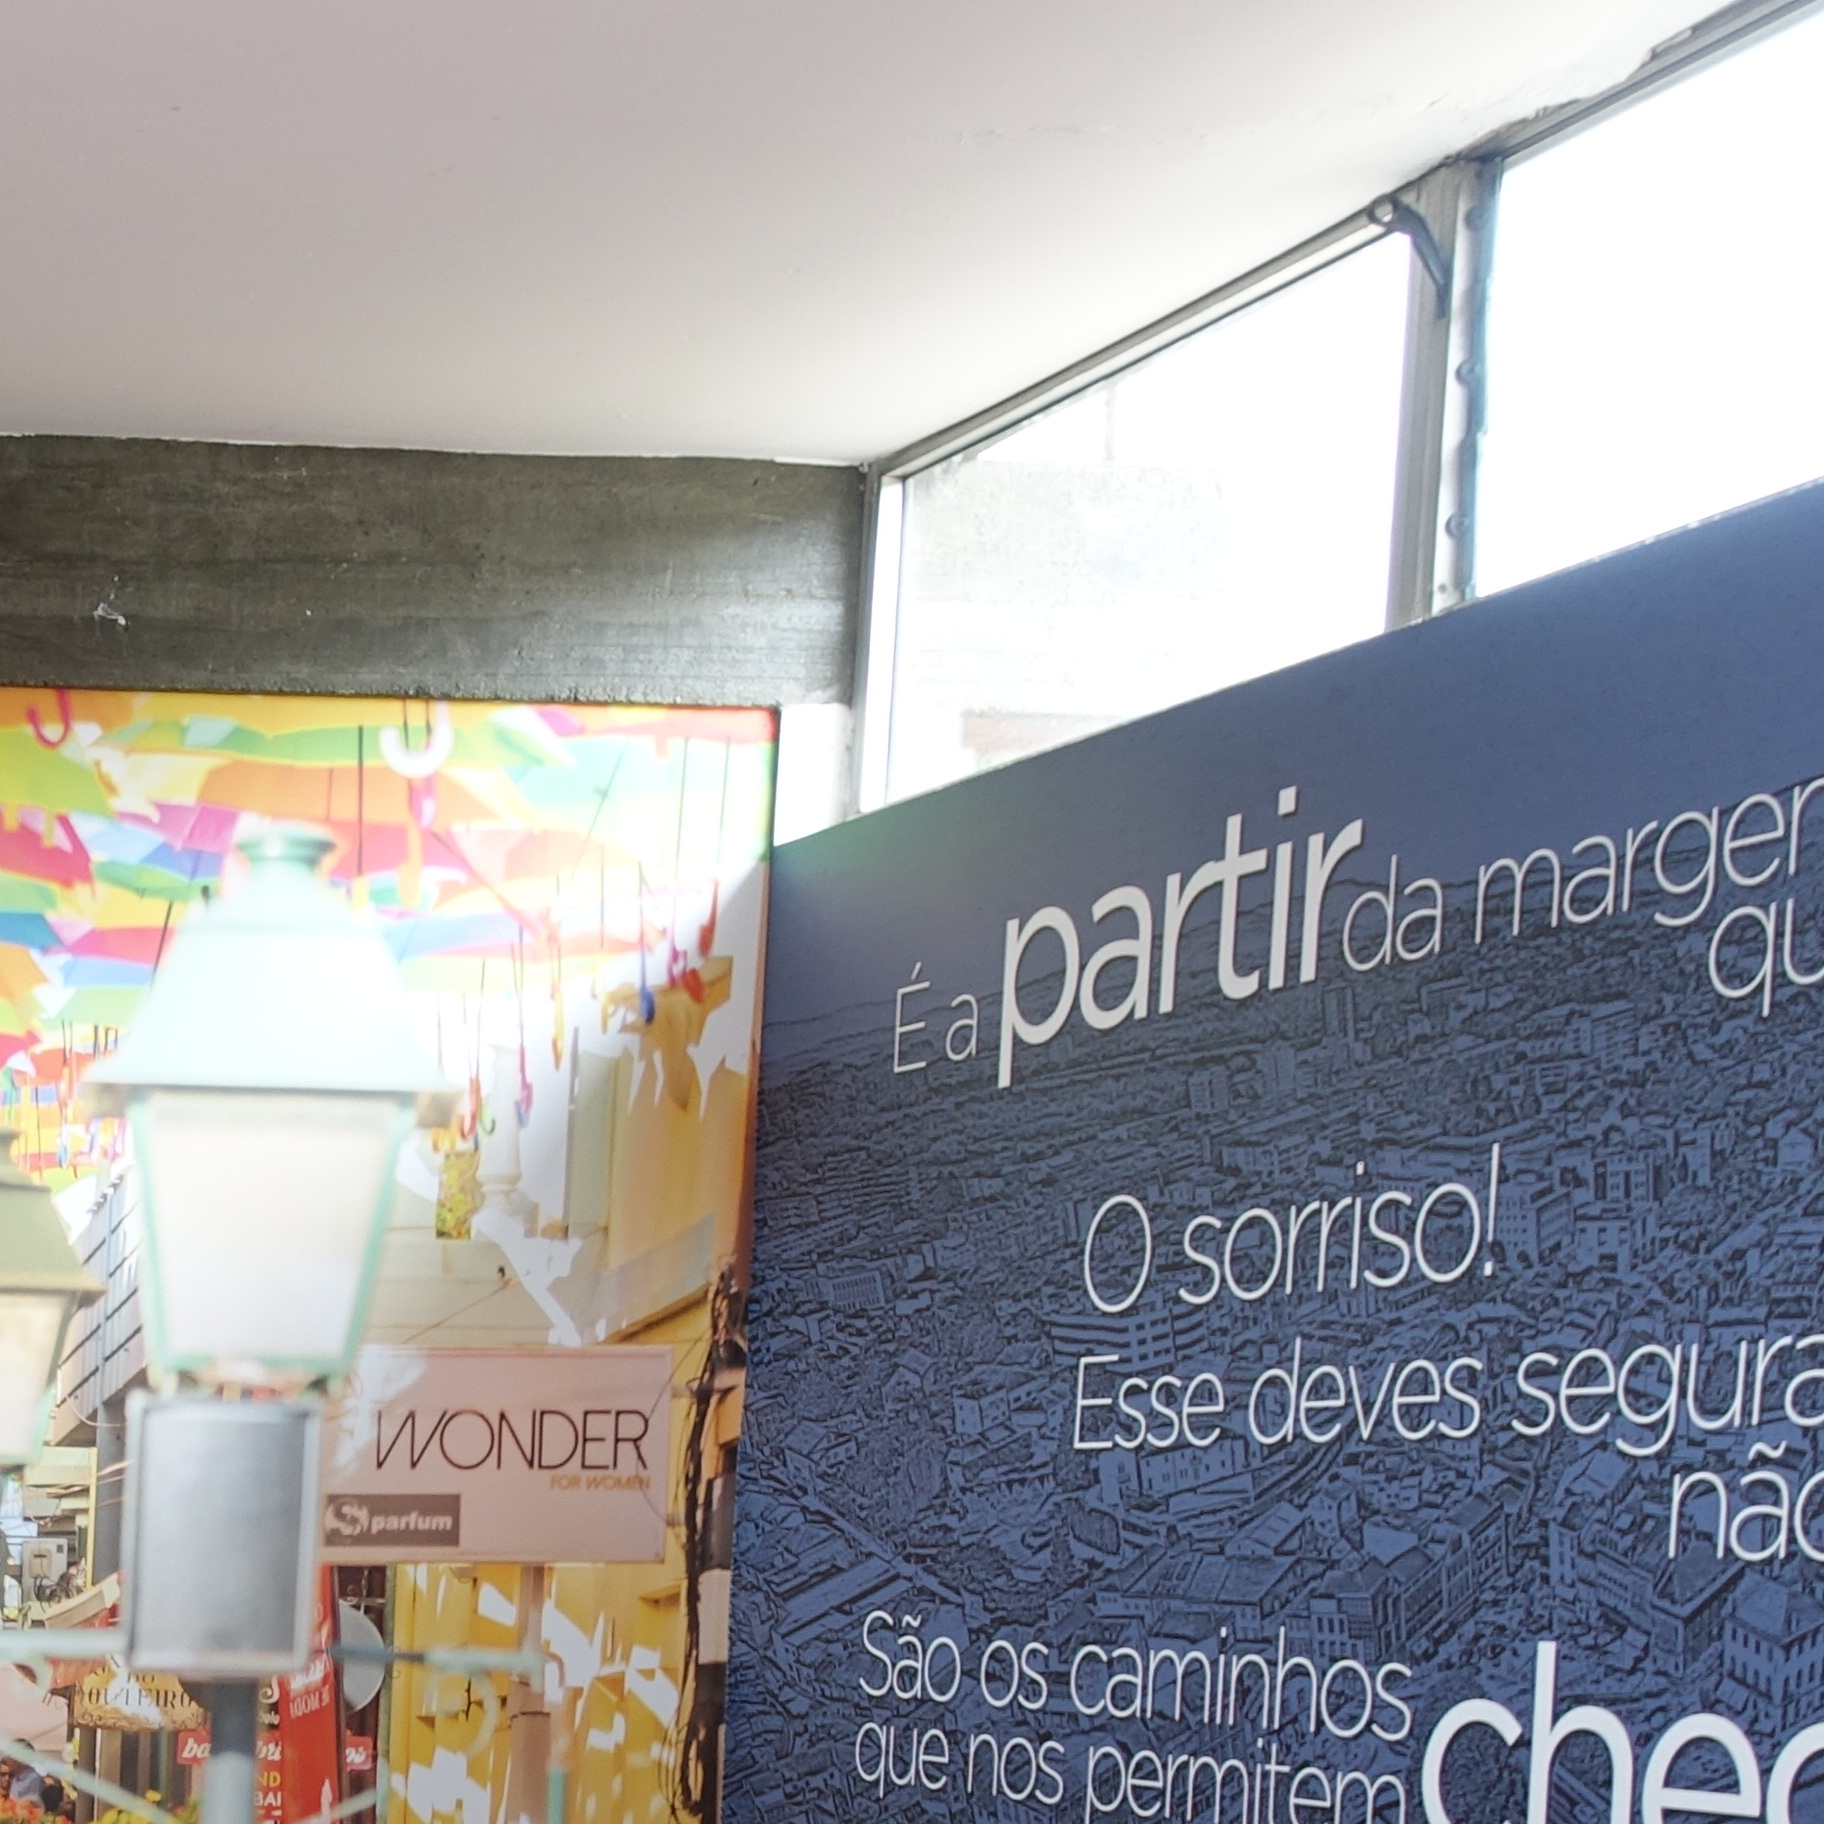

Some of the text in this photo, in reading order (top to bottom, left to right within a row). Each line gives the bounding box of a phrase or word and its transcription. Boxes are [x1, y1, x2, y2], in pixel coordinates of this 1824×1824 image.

[893, 961, 931, 1075] É
[945, 993, 979, 1063] a
[997, 785, 1364, 1089] partir
[1342, 855, 1444, 974] da
[1083, 1142, 1501, 1315] O sorriso!
[375, 1408, 649, 1471] WONDER
[1073, 1354, 1226, 1452] Esse
[1247, 1336, 1483, 1446] deves
[549, 1474, 651, 1491] FOR WOMEN
[858, 1608, 1414, 1743] São os caminhos
[854, 1718, 949, 1800] que
[966, 1729, 1067, 1805] nos
